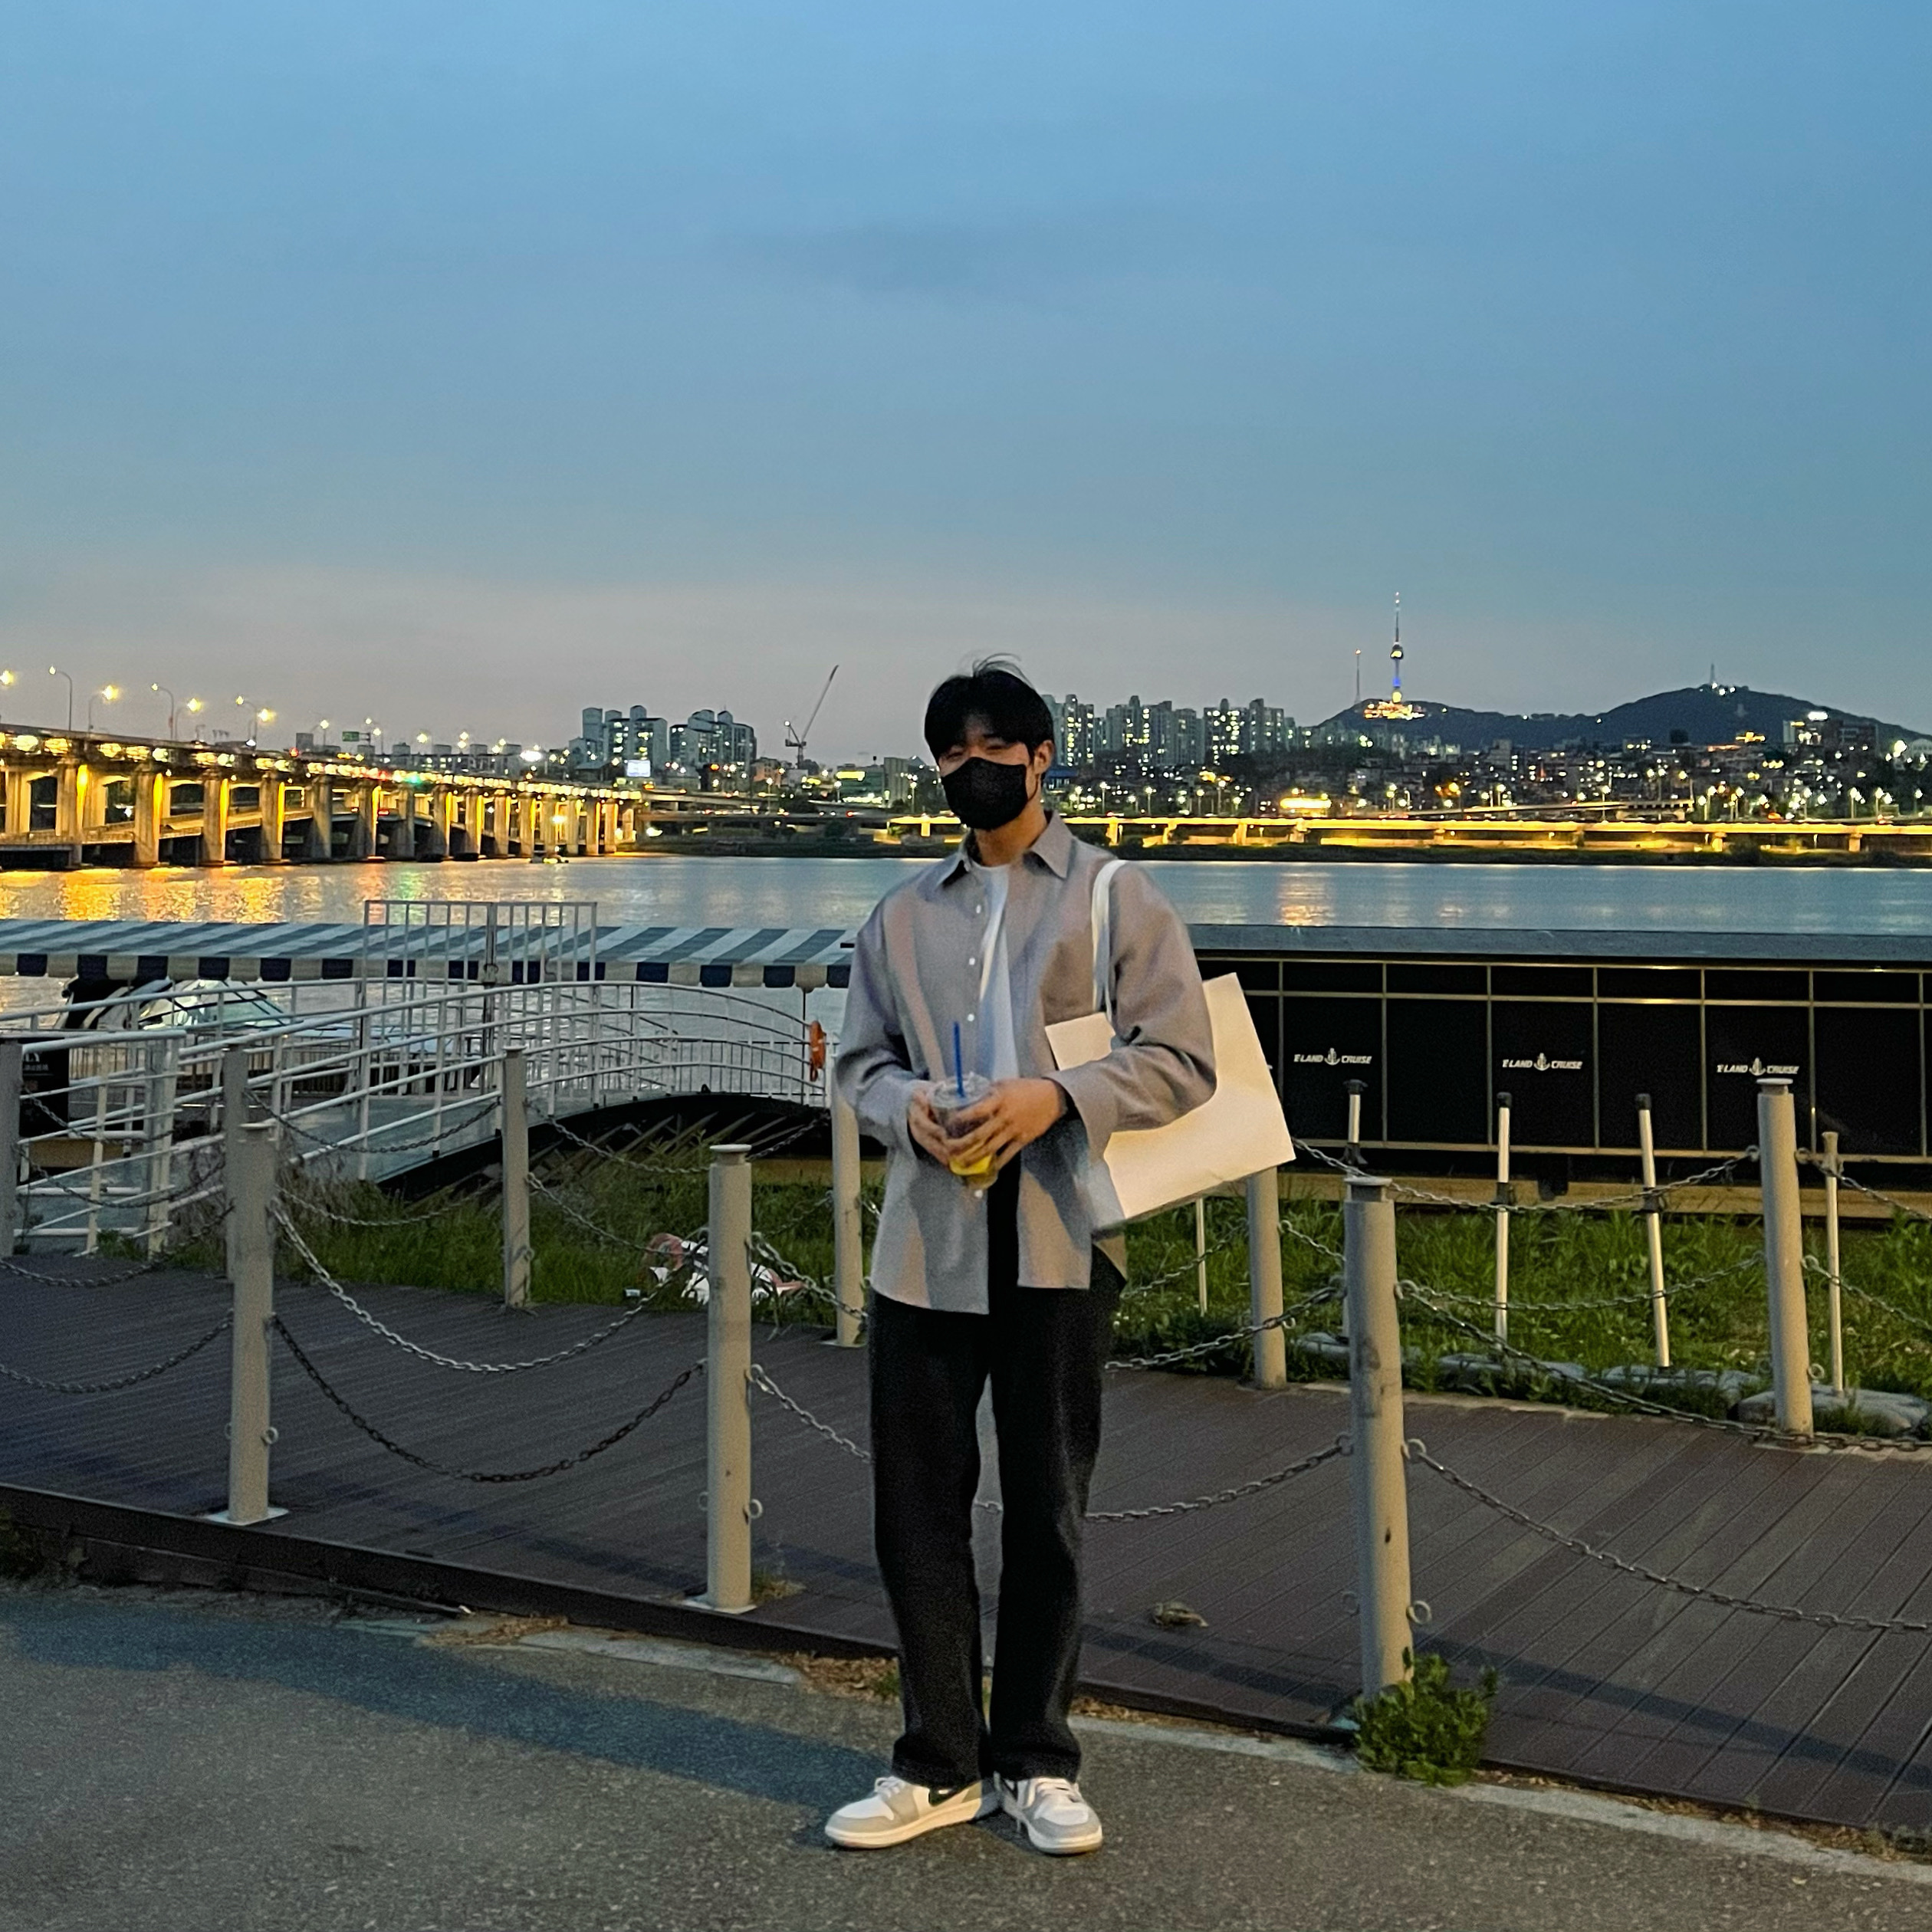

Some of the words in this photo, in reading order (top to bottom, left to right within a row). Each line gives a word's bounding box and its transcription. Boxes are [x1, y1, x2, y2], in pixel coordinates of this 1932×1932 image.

[1341, 1055, 1372, 1064] CRUISE
[1551, 1060, 1583, 1070] CRUISE
[1766, 1065, 1799, 1074] CRUISE
